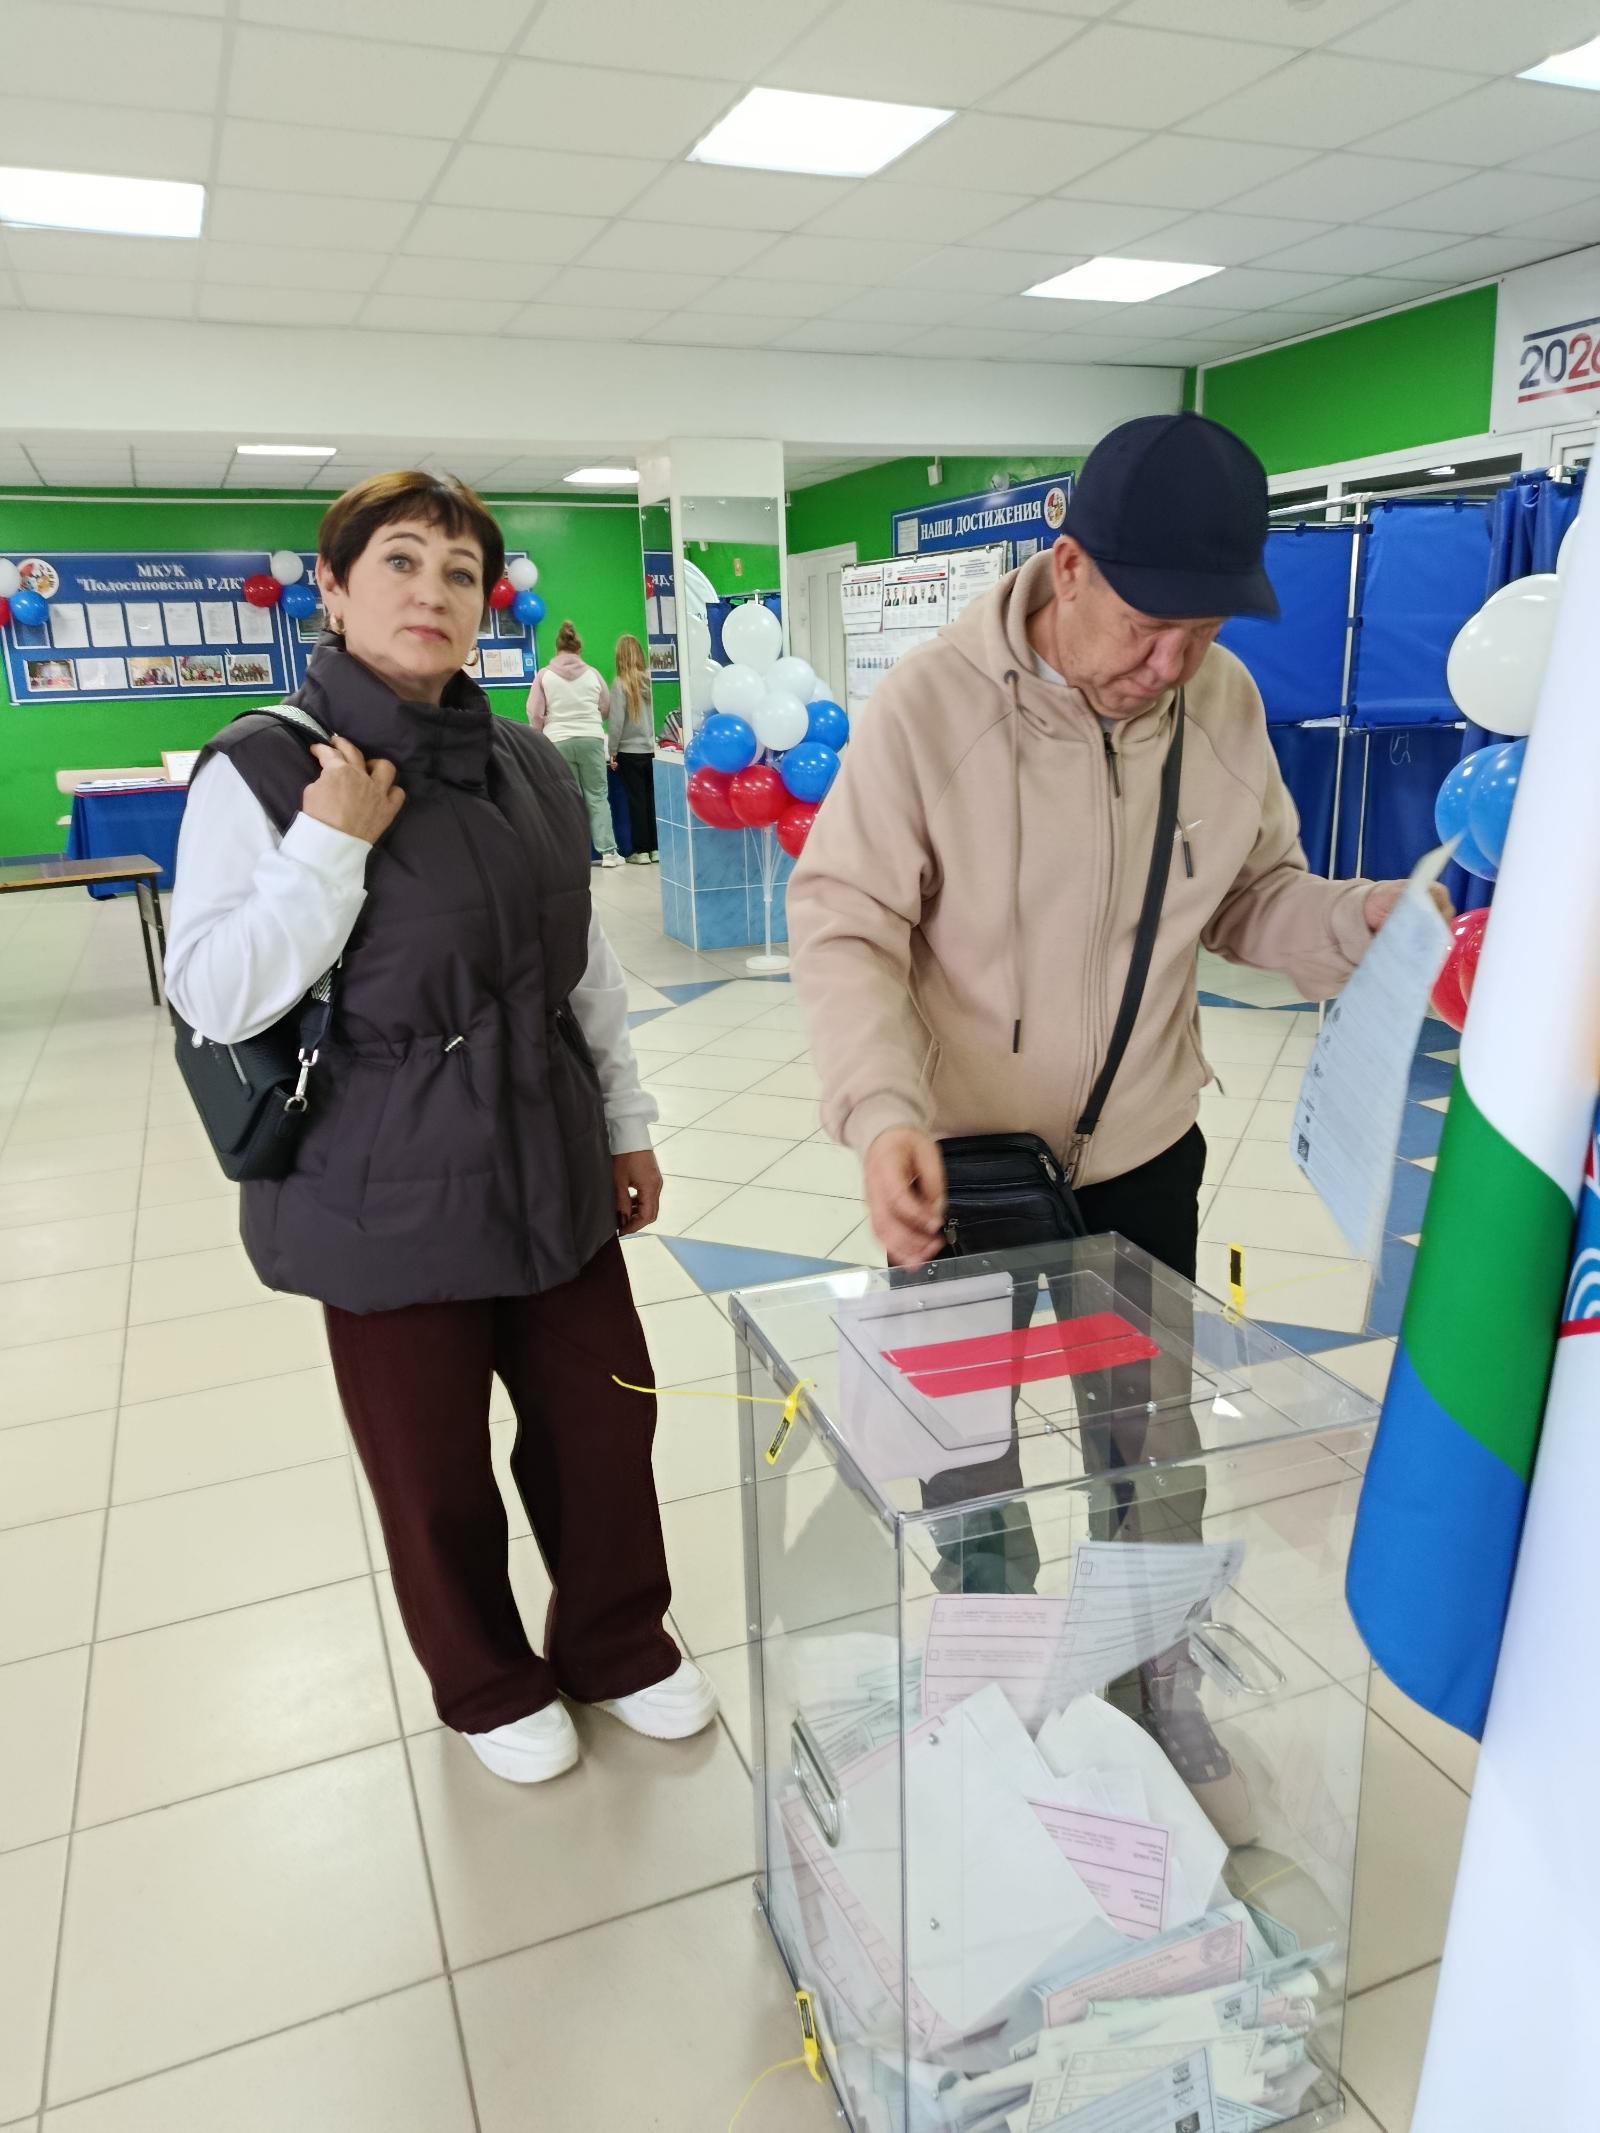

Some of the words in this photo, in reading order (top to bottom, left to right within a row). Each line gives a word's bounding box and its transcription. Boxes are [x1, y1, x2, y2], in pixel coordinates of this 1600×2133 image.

[920, 518, 953, 540] НАШИ
[954, 500, 1042, 537] ДОСТИЖЕНИЯ
[136, 562, 186, 578] МКУК
